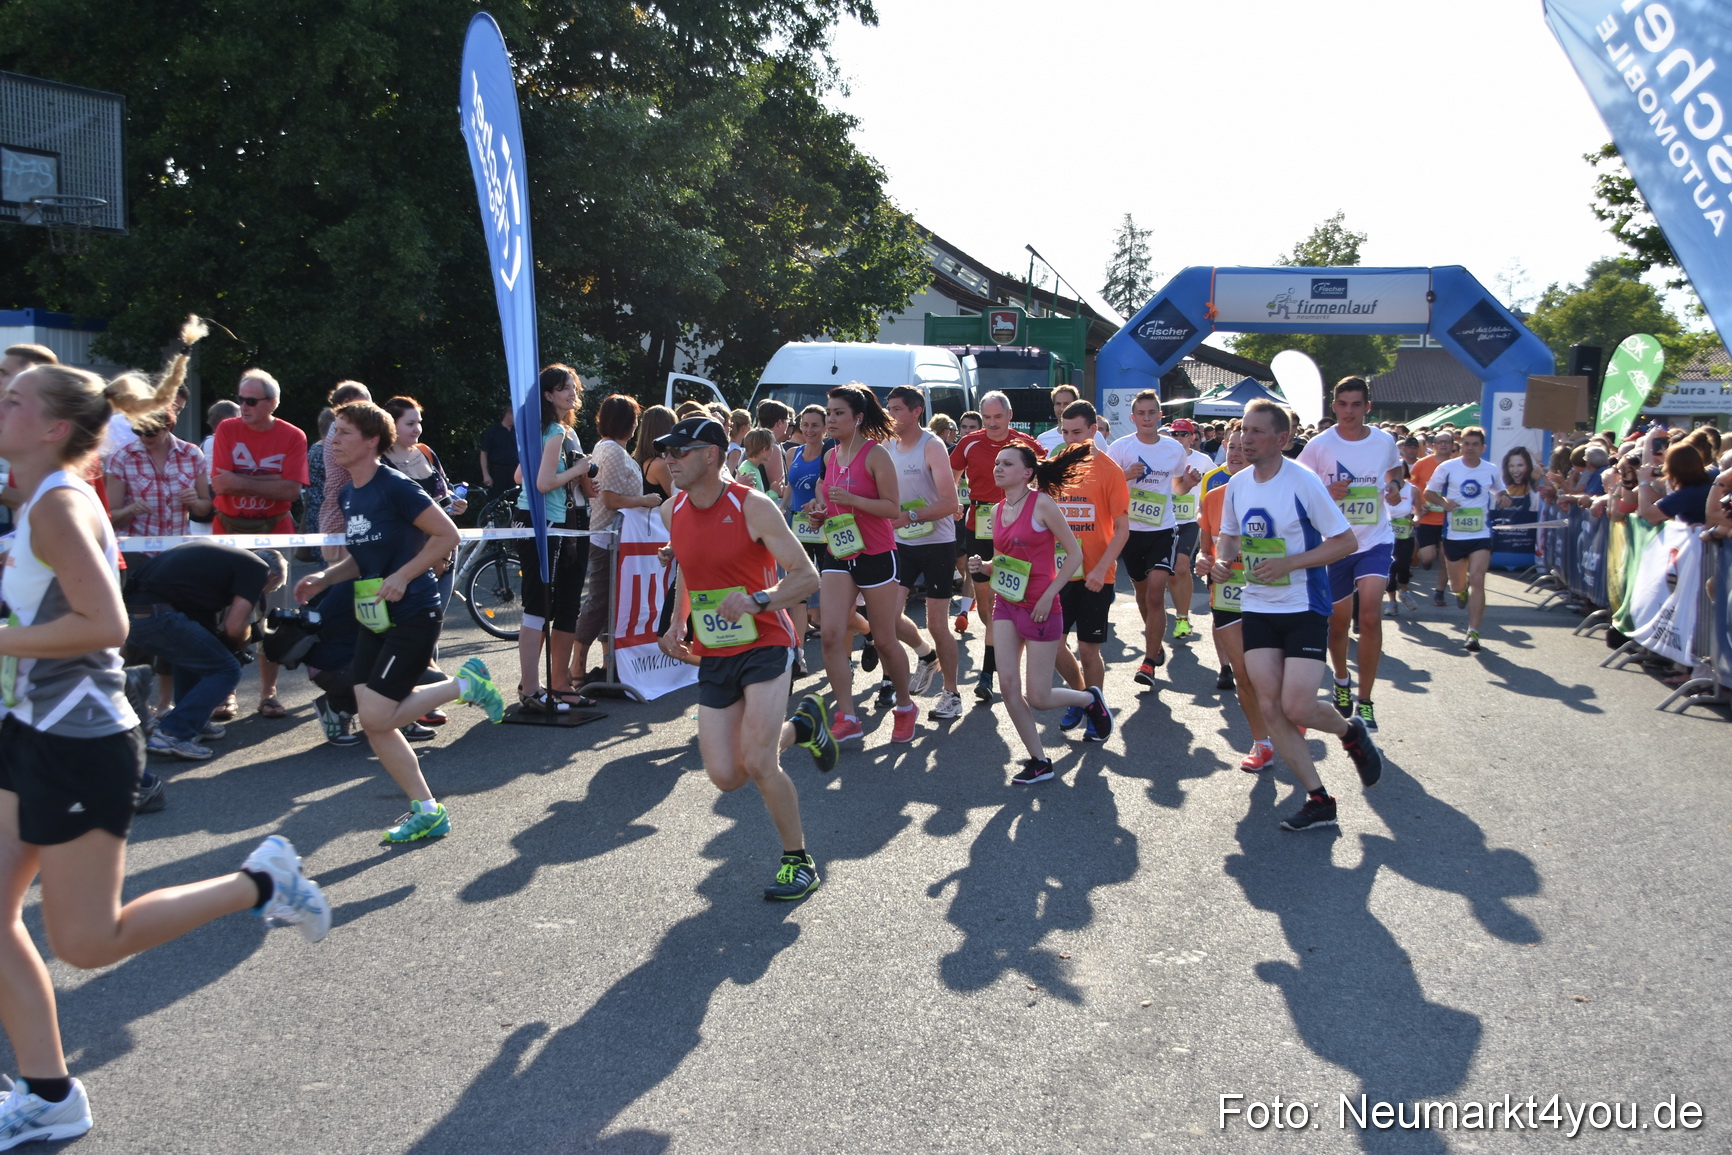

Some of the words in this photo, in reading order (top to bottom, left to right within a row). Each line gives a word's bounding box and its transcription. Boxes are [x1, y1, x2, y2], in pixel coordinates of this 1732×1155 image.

[1296, 299, 1379, 315] firmenlauf
[1146, 326, 1189, 336] Fischer
[1673, 385, 1706, 395] Jura
[1600, 390, 1631, 424] AOK
[1131, 501, 1161, 517] 1468
[1338, 502, 1375, 515] 1470
[1246, 521, 1266, 532] TÜV
[1455, 518, 1479, 527] 1481
[833, 529, 855, 547] 358
[998, 571, 1020, 591] 359
[703, 613, 743, 632] 962
